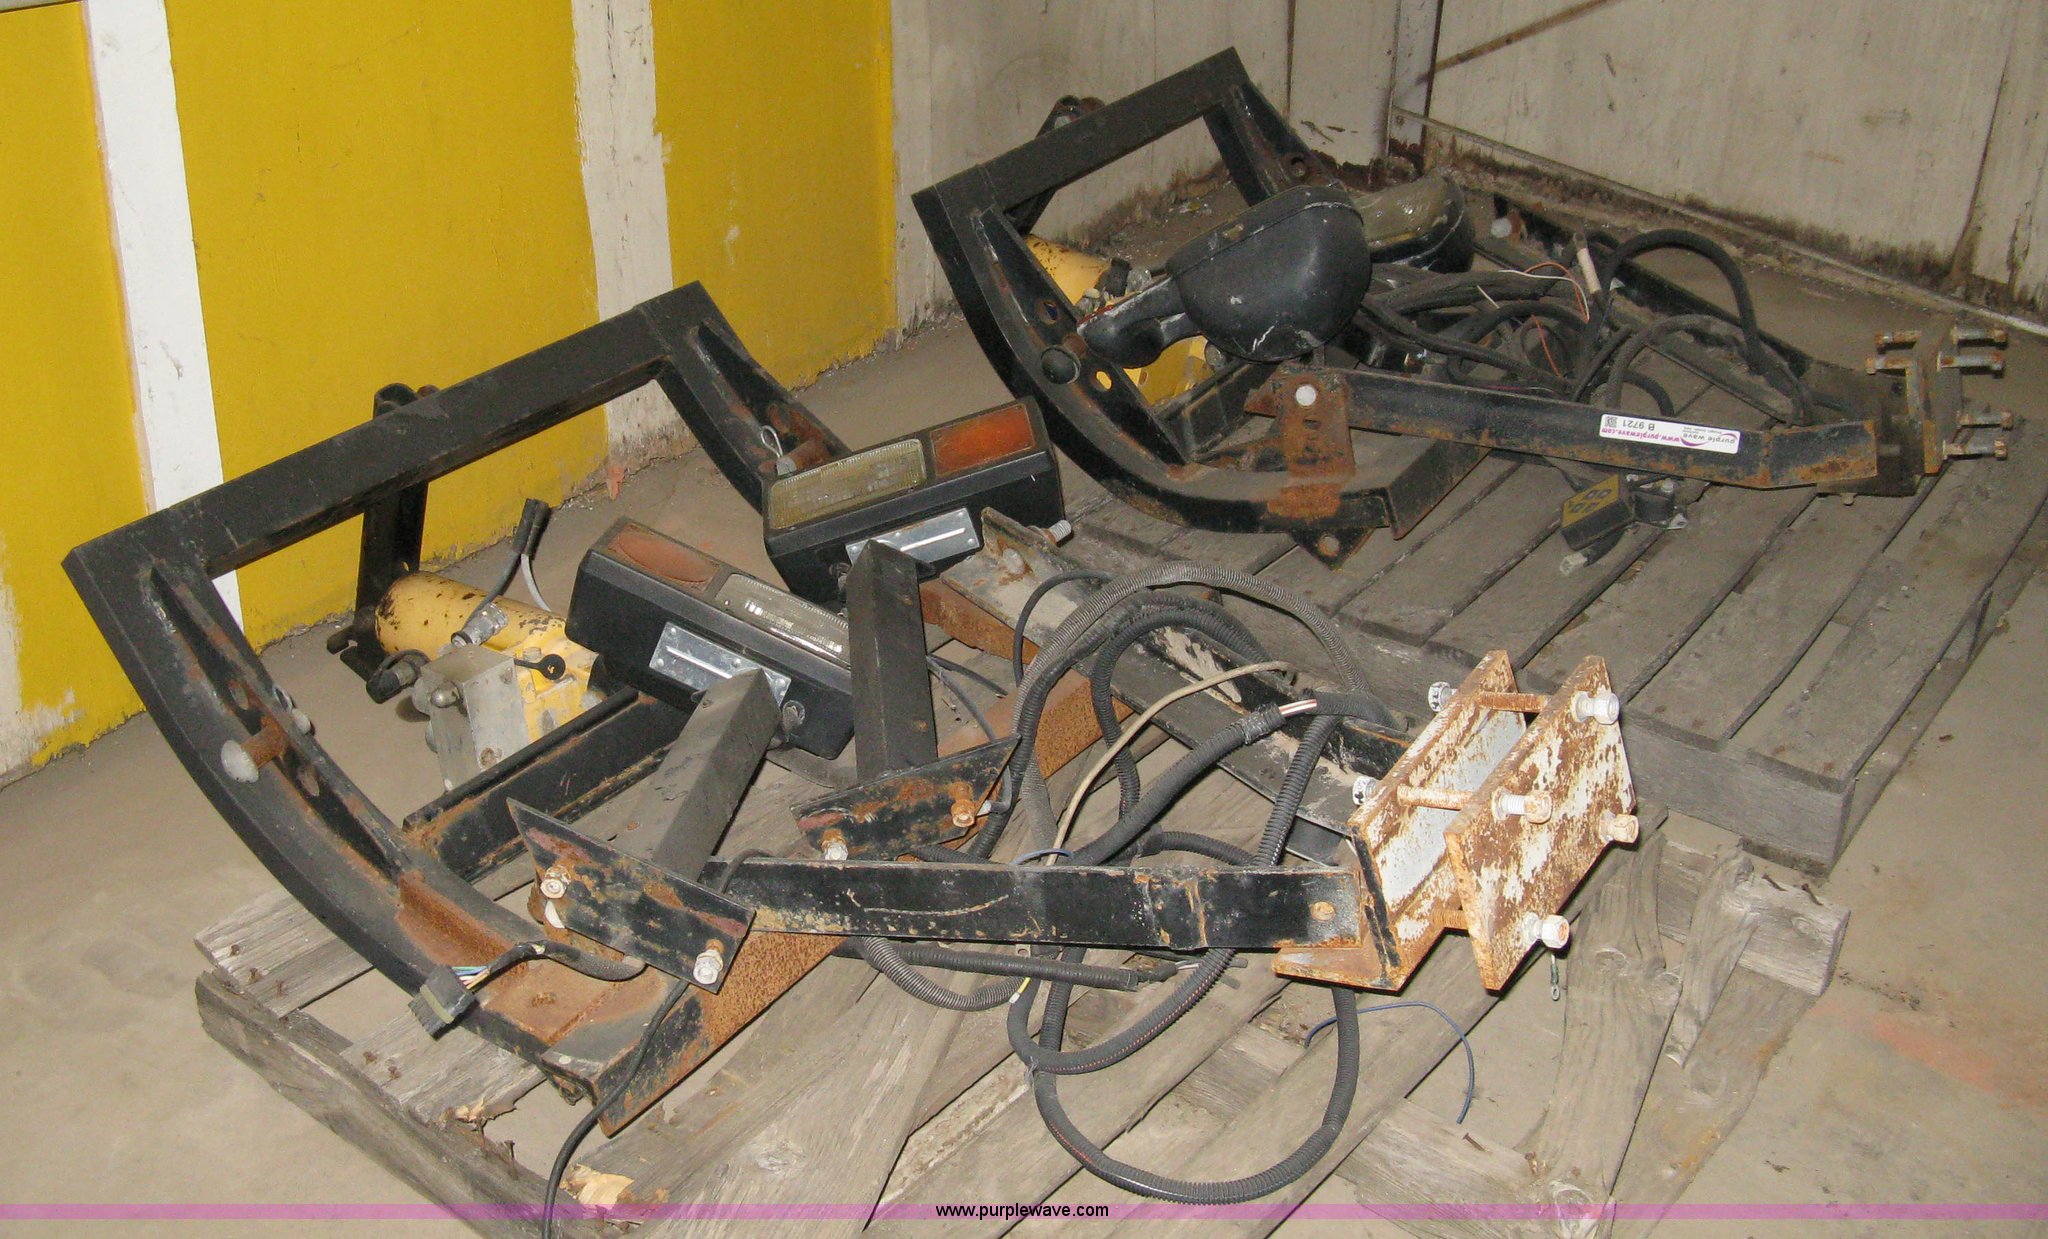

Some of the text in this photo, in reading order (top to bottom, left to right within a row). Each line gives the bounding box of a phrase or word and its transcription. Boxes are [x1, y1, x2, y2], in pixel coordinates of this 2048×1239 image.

[1622, 419, 1655, 431] B 9721
[1601, 428, 1680, 442] www.purplewave.com
[1683, 433, 1736, 444] purple wave
